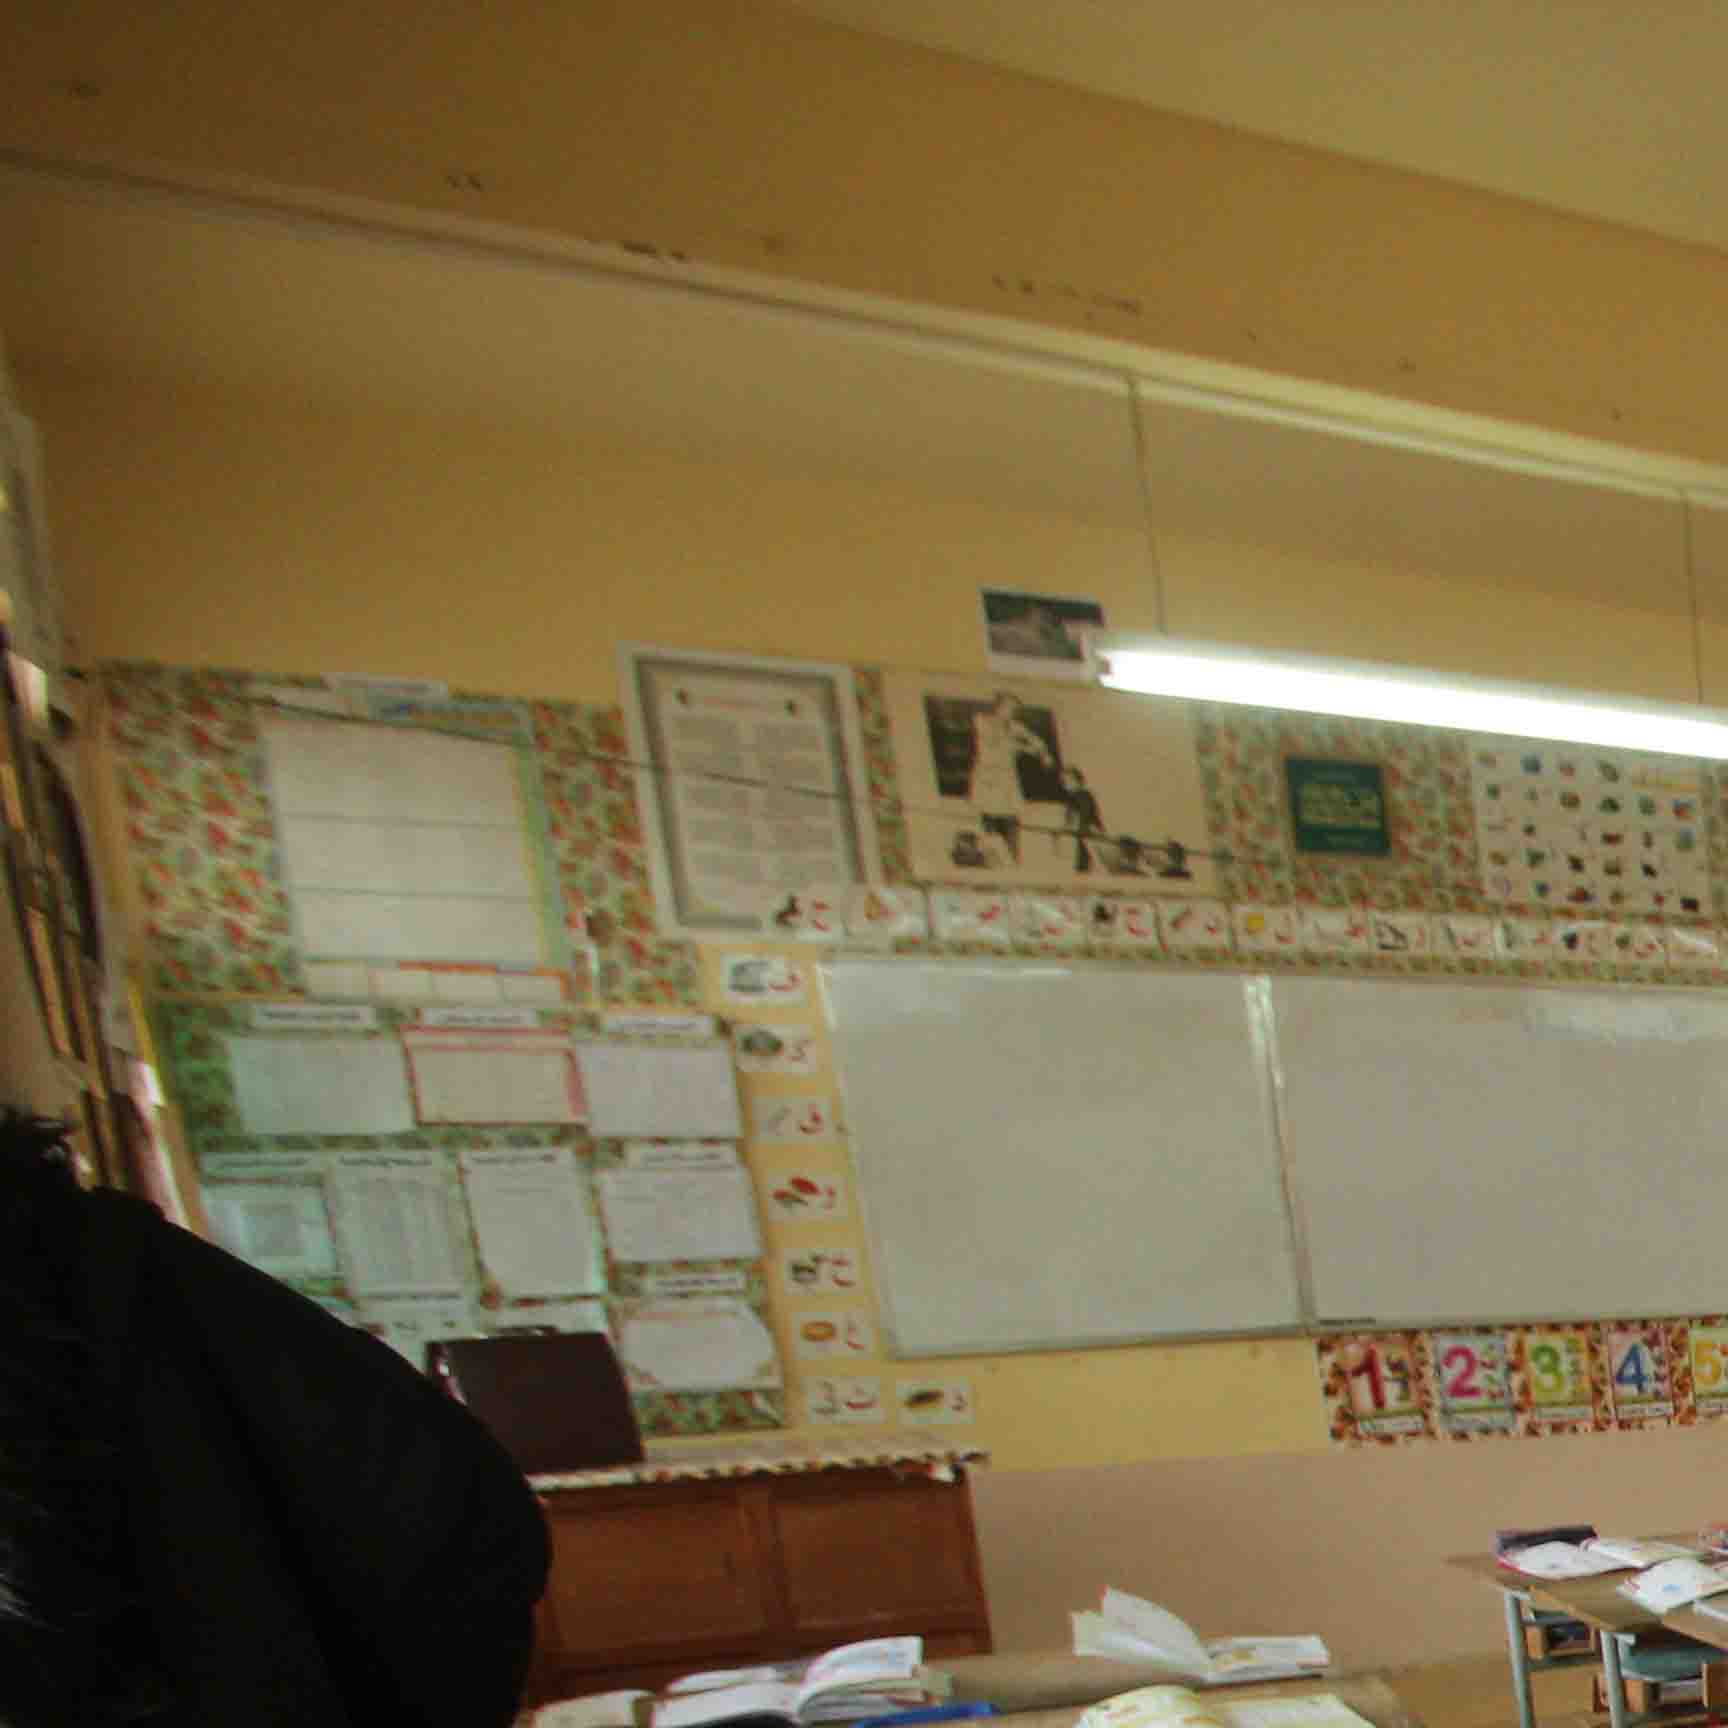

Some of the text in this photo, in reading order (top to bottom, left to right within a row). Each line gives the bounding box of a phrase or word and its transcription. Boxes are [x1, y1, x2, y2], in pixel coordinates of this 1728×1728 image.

[1346, 1343, 1386, 1410] 1
[1441, 1345, 1482, 1399] 2
[1531, 1344, 1564, 1395] 3
[1615, 1343, 1648, 1397] 4
[1694, 1339, 1722, 1386] 5
